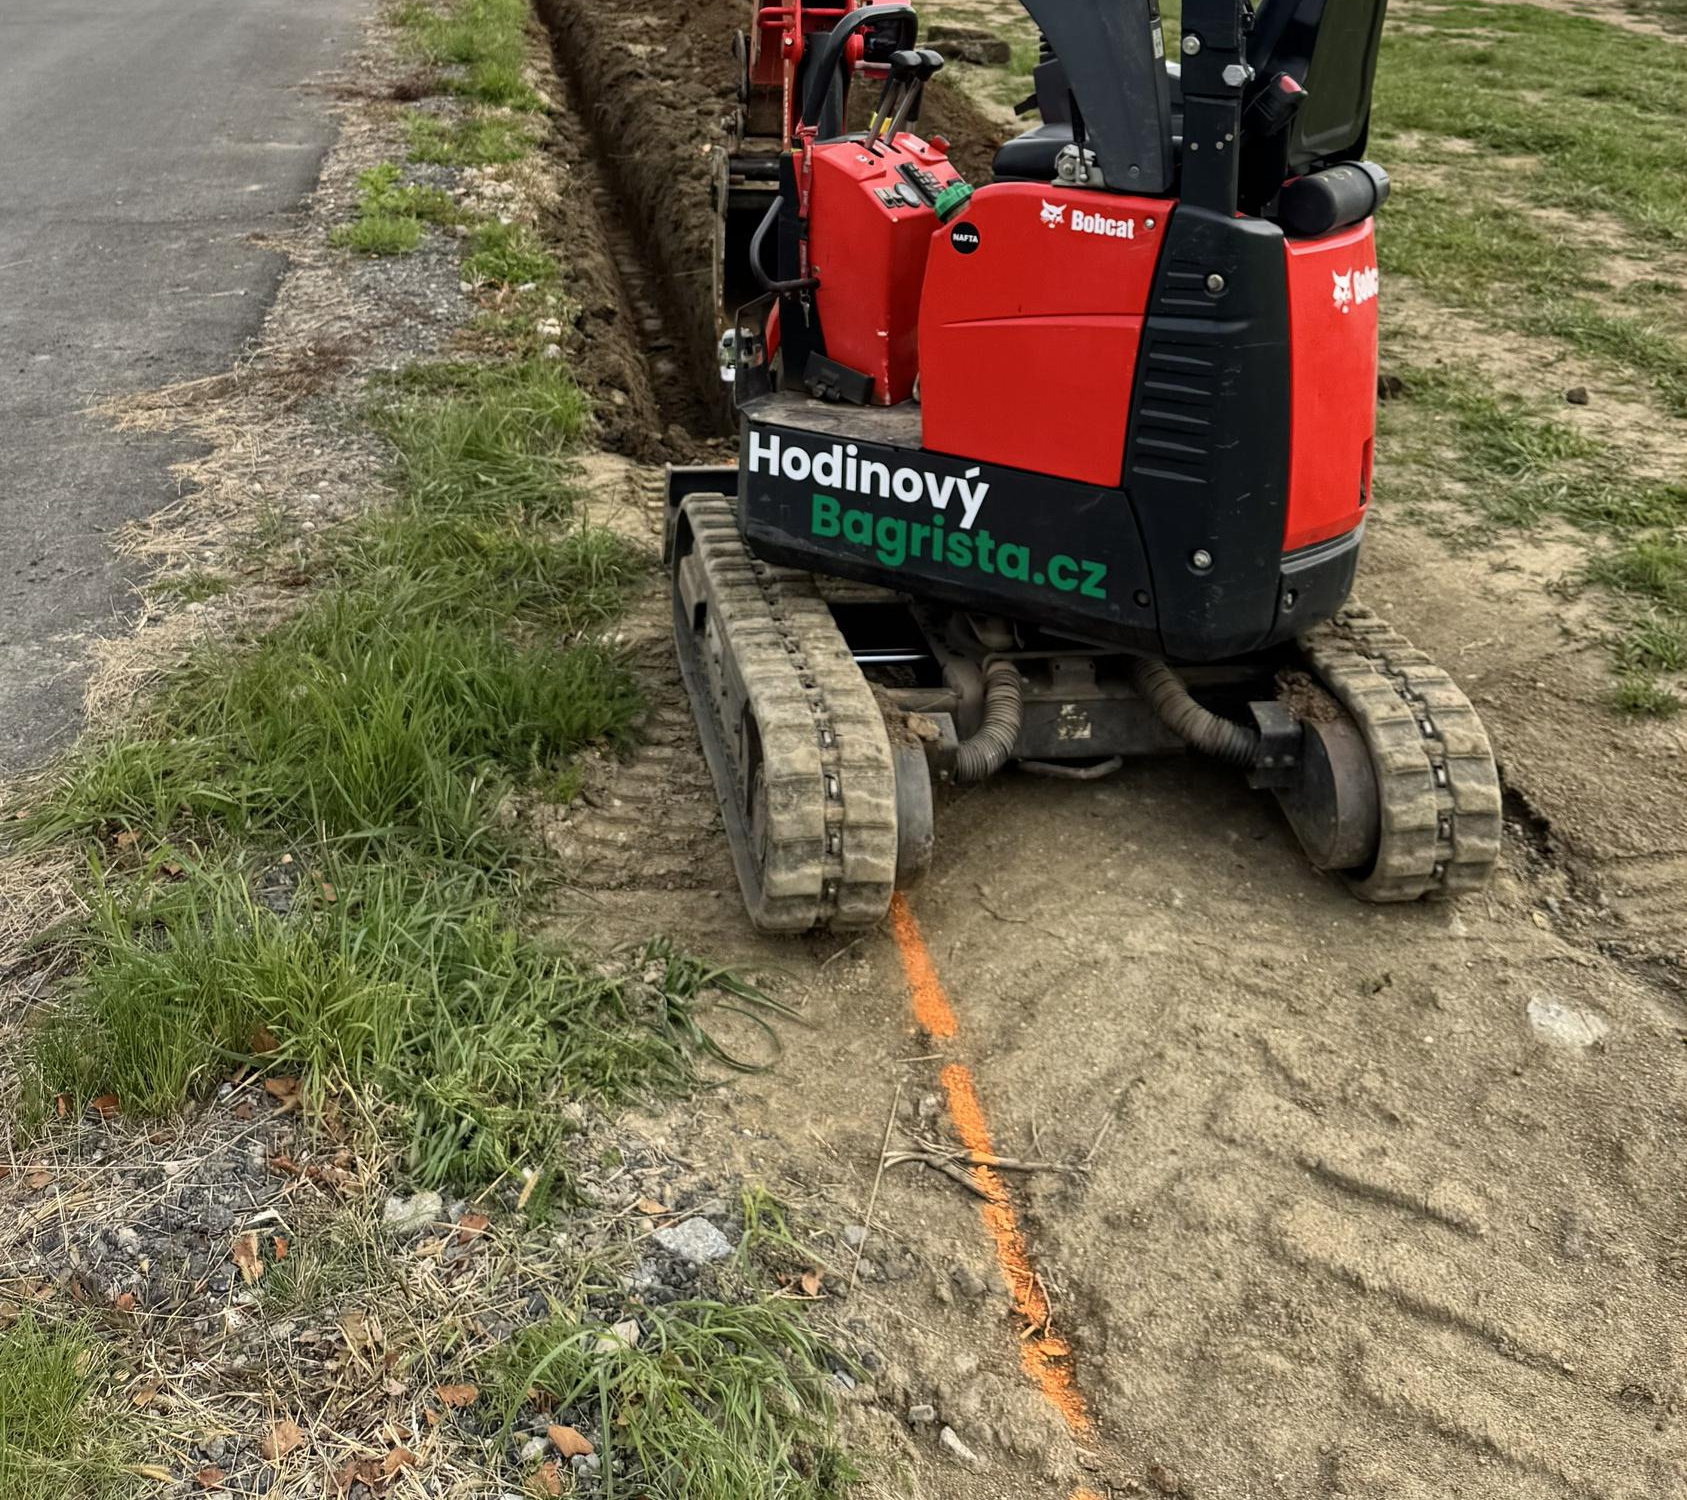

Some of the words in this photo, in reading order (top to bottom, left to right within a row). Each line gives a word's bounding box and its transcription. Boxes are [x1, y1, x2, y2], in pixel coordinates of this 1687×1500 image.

[952, 233, 979, 244] NAFTA
[1070, 209, 1135, 240] Bobcat
[748, 431, 990, 530] Hodinový
[811, 493, 1108, 599] Bagrista.cz
